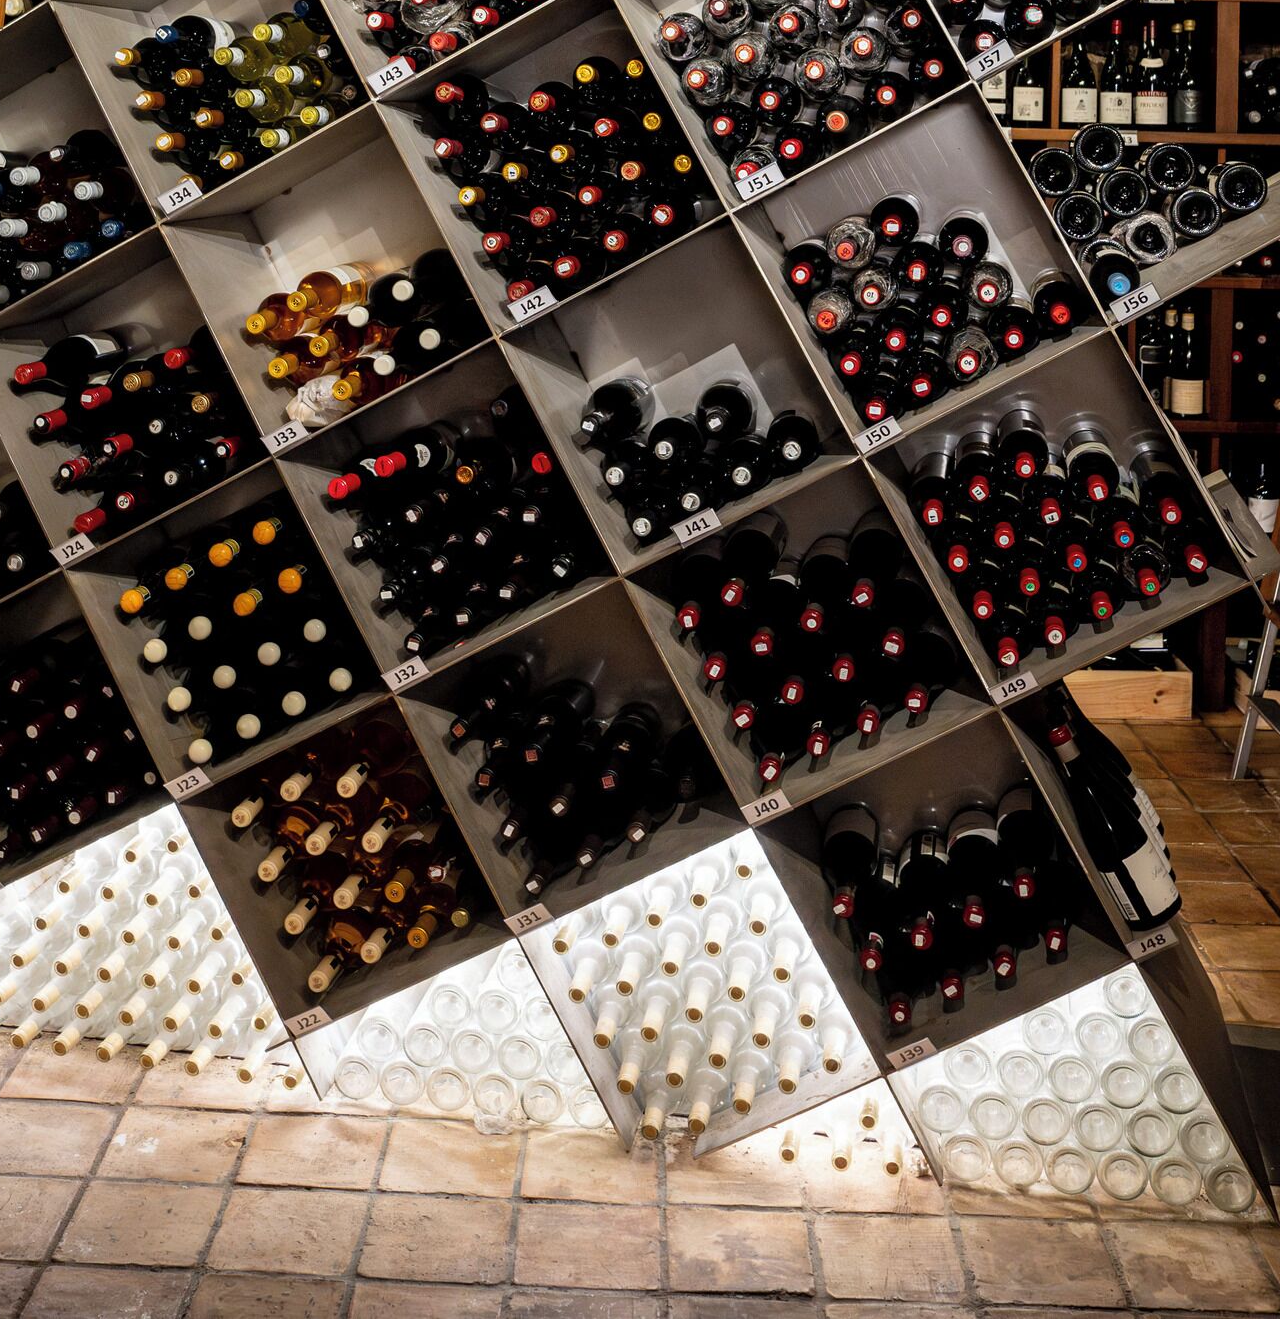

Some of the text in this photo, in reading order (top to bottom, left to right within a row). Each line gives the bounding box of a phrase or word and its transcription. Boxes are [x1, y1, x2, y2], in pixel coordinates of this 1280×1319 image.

[978, 50, 1001, 72] J57
[379, 66, 403, 86] J43
[748, 173, 773, 193] J51
[168, 187, 192, 207] J34
[520, 295, 545, 315] J42
[1122, 294, 1148, 313] J56
[274, 427, 297, 446] J33
[866, 425, 891, 446] J50
[685, 515, 711, 536] J41
[62, 541, 84, 559] J24
[394, 665, 419, 684] J32
[1001, 678, 1026, 698] J49
[176, 775, 200, 793] J23
[754, 799, 779, 817] J40
[517, 911, 542, 929] J31
[1140, 934, 1166, 953] J48
[297, 1014, 321, 1030] J22
[899, 1045, 924, 1063] J39
